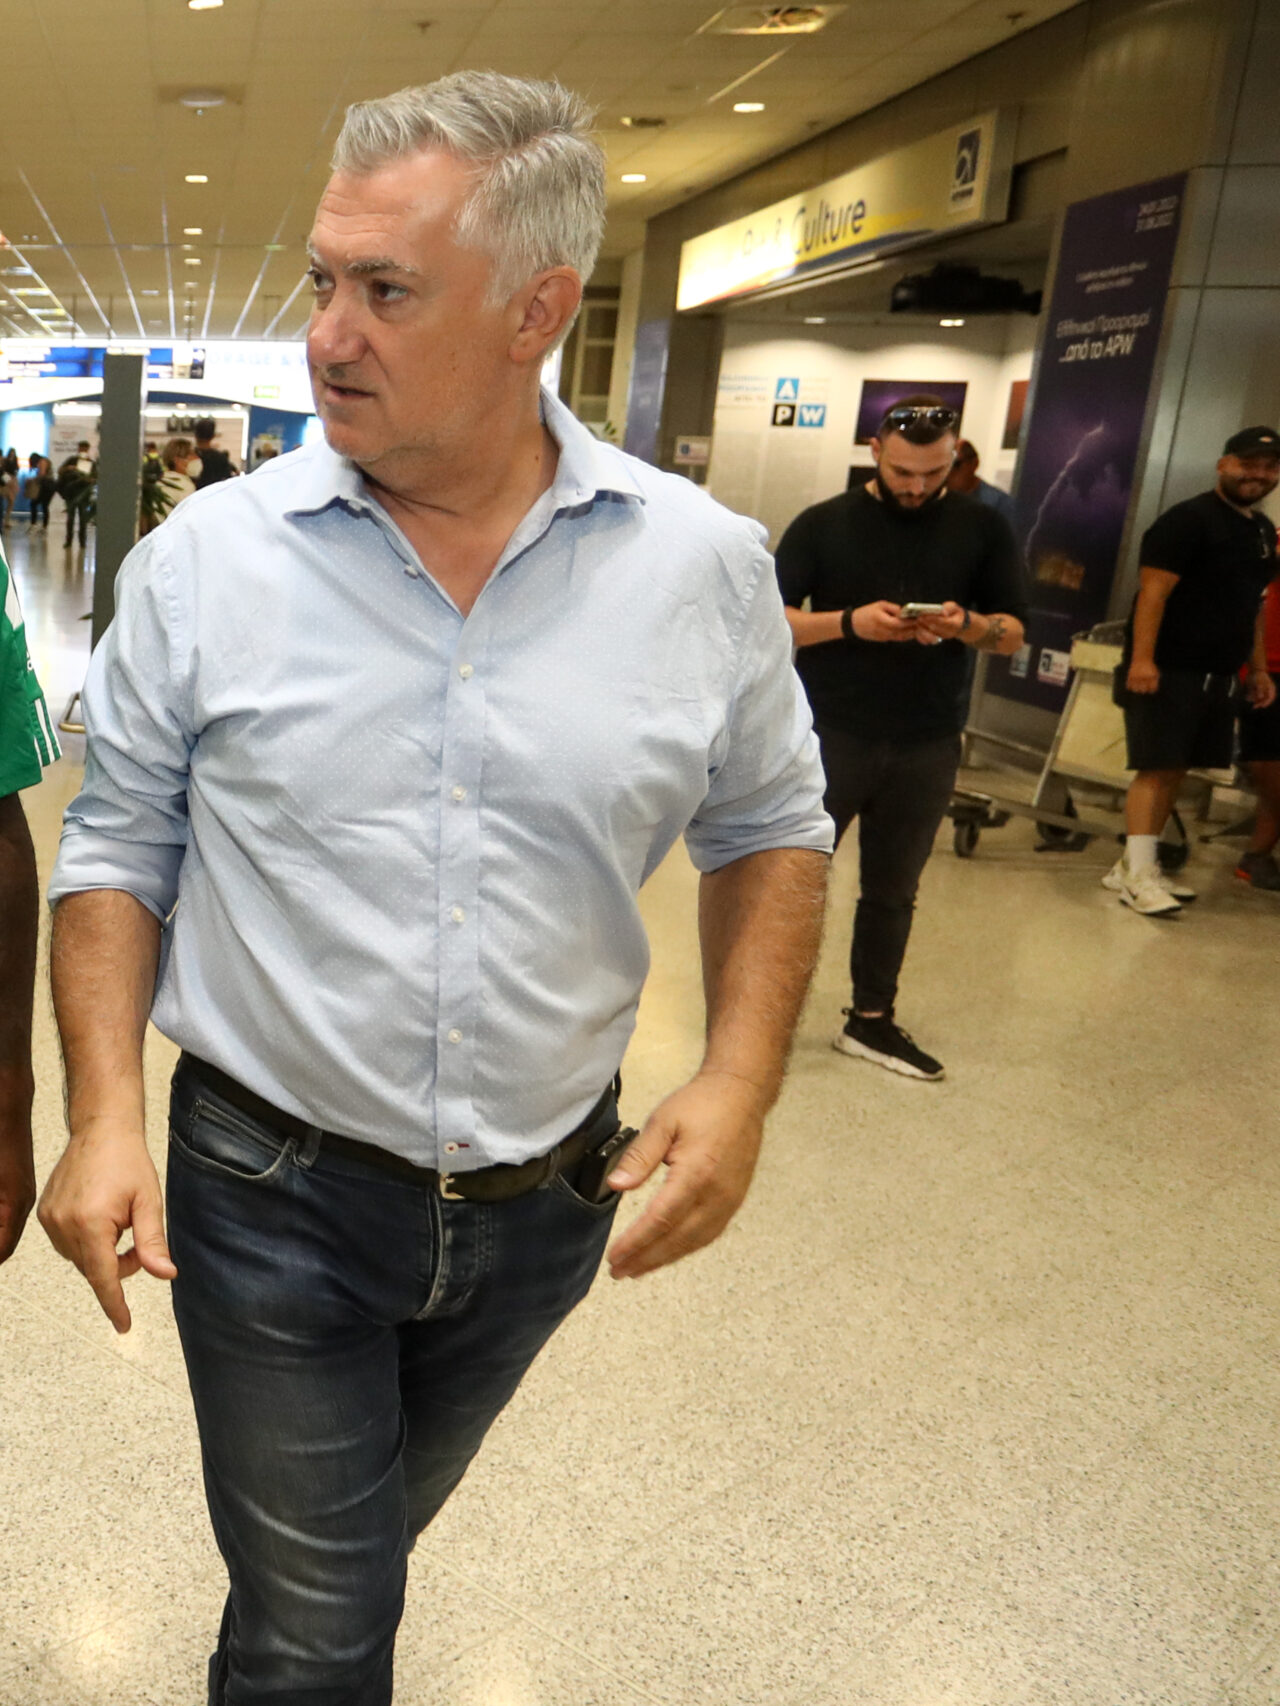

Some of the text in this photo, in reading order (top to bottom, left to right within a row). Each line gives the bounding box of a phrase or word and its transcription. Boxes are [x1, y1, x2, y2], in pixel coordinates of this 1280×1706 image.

[792, 199, 867, 255] Culture
[777, 379, 797, 398] A
[775, 405, 824, 425] P W
